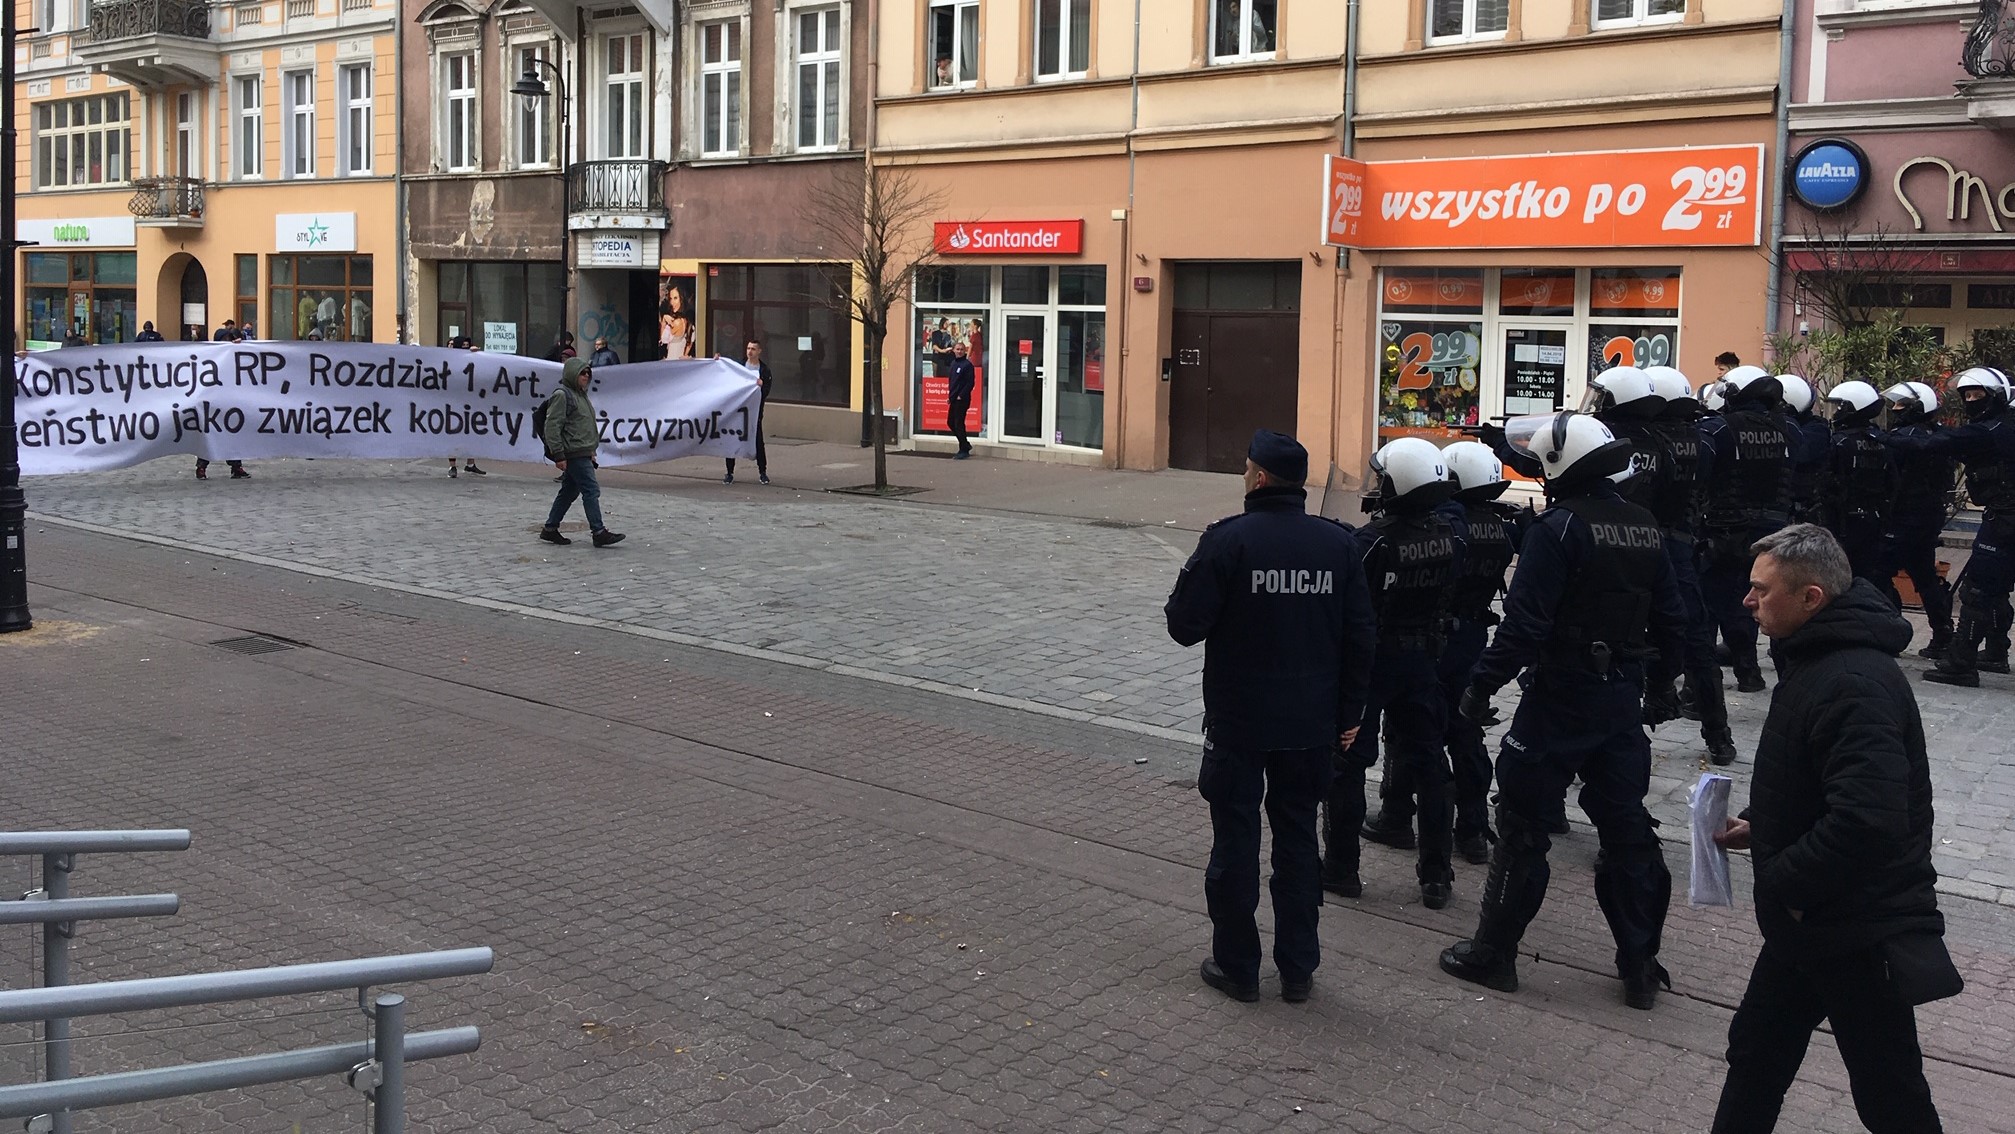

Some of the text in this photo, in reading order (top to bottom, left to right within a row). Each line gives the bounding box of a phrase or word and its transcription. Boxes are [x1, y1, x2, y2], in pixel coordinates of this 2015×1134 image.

[1798, 162, 1856, 178] LAVAZZA
[1381, 180, 1571, 228] wszystko
[1583, 183, 1647, 224] po
[1716, 210, 1733, 229] zł
[53, 224, 88, 241] natura
[972, 228, 1061, 248] Santander
[1138, 278, 1145, 286] 6
[1644, 284, 1664, 296] 4.99
[14, 354, 223, 403] Konstytucja
[234, 351, 291, 394] RP,
[309, 353, 452, 390] Rozdział
[492, 366, 545, 398] Art.
[1443, 367, 1457, 385] zł
[1517, 375, 1533, 383] 10.00
[1538, 376, 1555, 384] 18.00
[1516, 389, 1533, 397] 10.00
[1538, 390, 1555, 398] 14.00
[1649, 382, 1655, 393] U
[1684, 385, 1690, 395] U
[17, 408, 159, 447] eństwo
[172, 401, 245, 443] jako
[257, 401, 392, 439] związek
[409, 402, 523, 446] kobiety
[596, 406, 749, 449] żczyzny[...]
[1601, 427, 1611, 439] U
[1739, 431, 1785, 445] POLICJA
[1435, 464, 1443, 477] U
[1493, 463, 1500, 474] U
[1590, 523, 1661, 549] POLICJA
[1398, 537, 1453, 562] POLICJA
[1251, 569, 1333, 594] POLICJA
